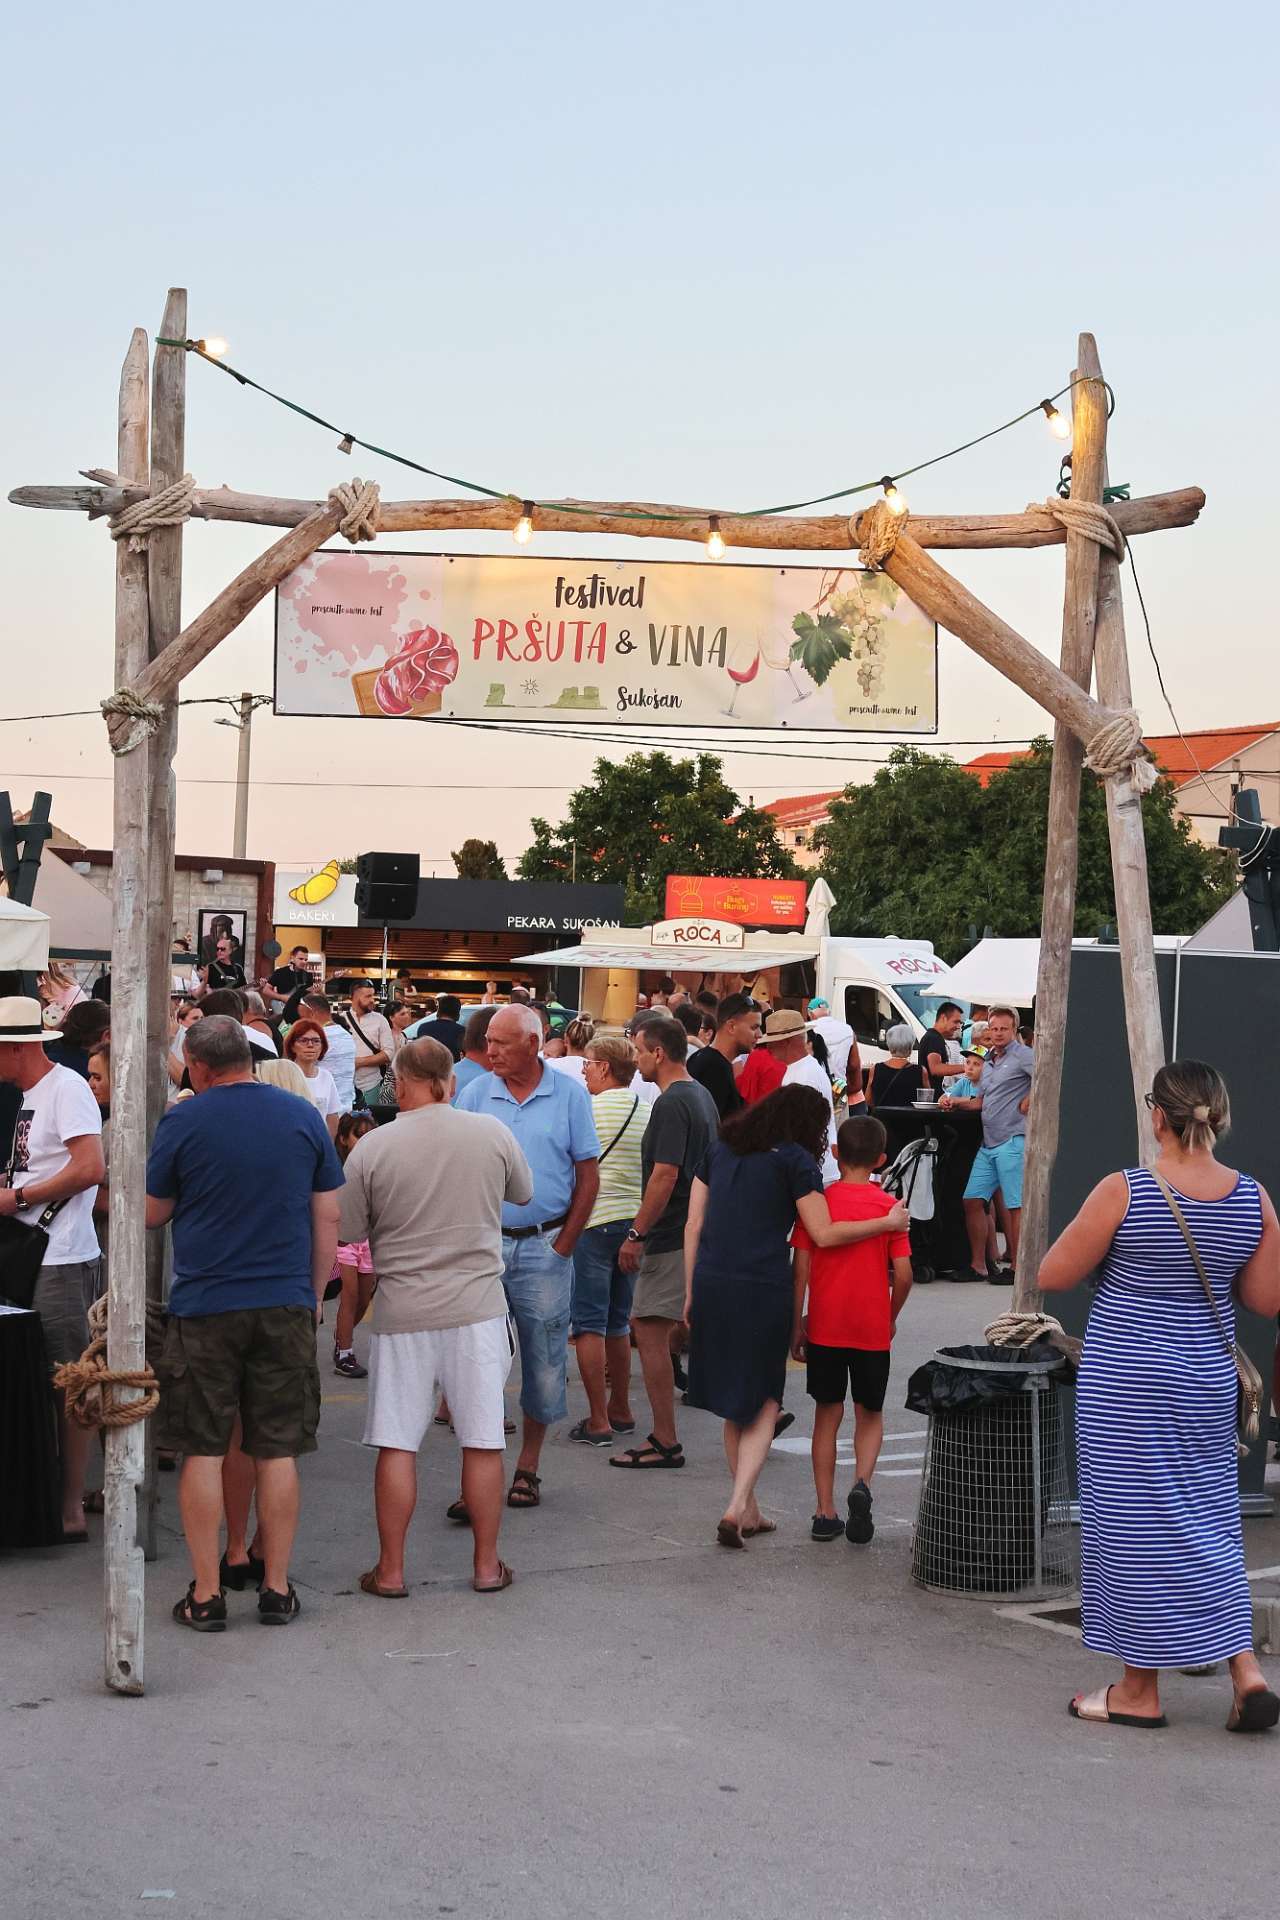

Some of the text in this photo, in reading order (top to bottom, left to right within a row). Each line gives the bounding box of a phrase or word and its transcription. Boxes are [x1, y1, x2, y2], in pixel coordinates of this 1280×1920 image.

[472, 613, 728, 668] PRŠUTA & VINA
[289, 910, 336, 921] BAKERY
[507, 916, 620, 930] PEKARA SUKOŠAN
[673, 926, 721, 945] ROCA
[886, 958, 946, 976] ROCA
